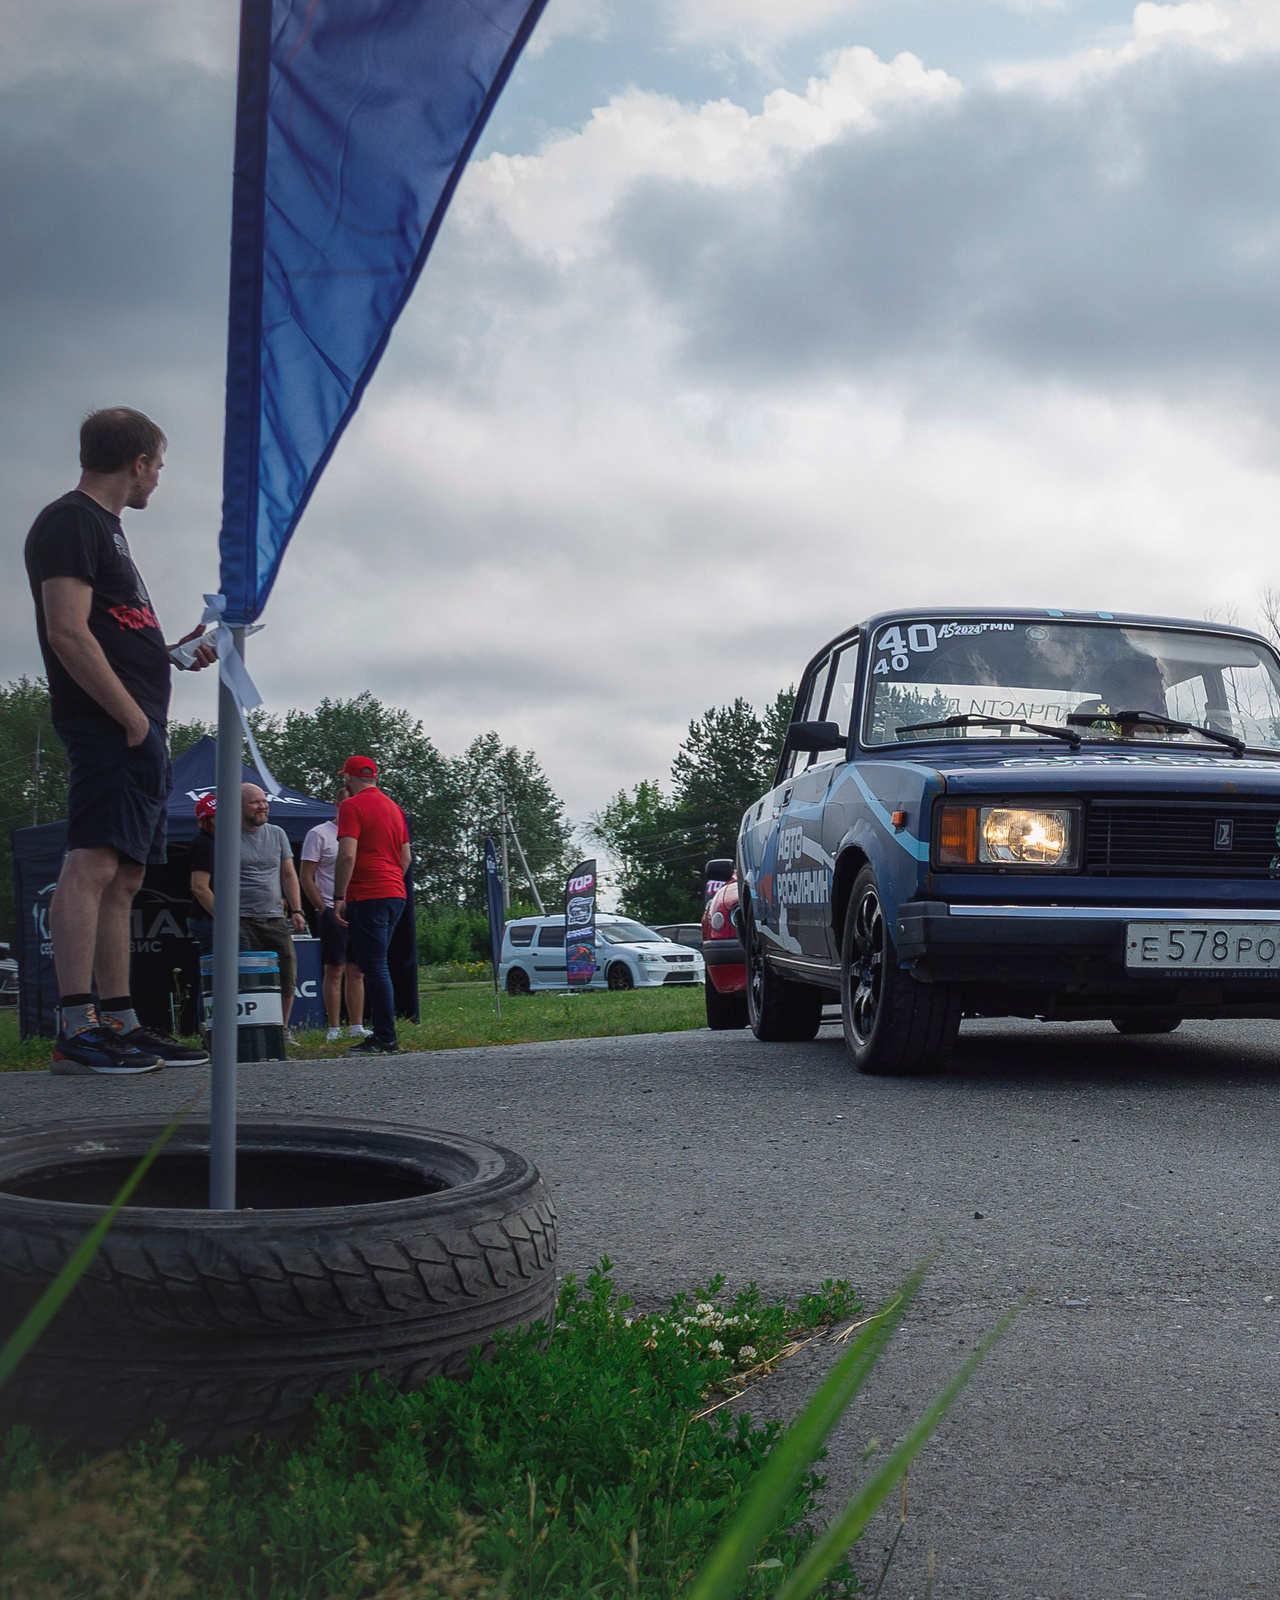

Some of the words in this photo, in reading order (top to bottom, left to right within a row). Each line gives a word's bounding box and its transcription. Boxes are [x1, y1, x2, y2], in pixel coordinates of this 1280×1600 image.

[877, 623, 938, 656] 40
[980, 623, 1015, 631] TMN
[872, 654, 910, 675] 40
[778, 826, 803, 861] АВТО
[568, 874, 595, 894] TOP
[776, 869, 829, 904] РОССИЯНИН
